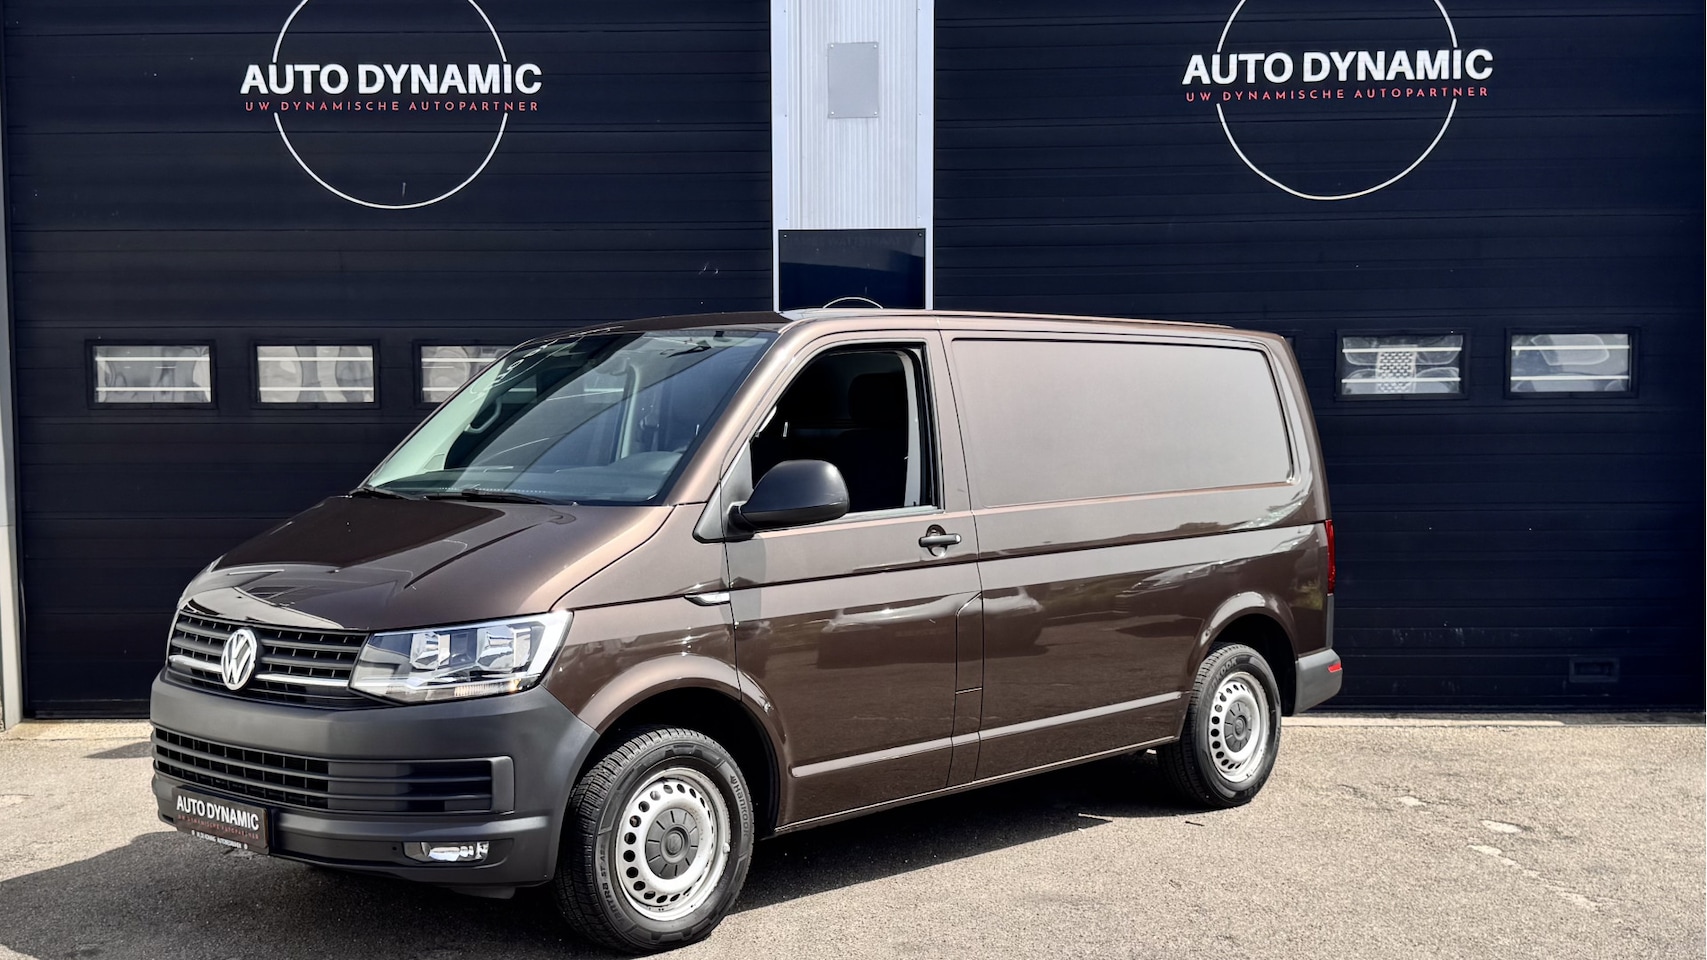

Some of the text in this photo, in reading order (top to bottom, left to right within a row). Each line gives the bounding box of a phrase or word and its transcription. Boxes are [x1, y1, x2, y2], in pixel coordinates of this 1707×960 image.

[240, 63, 543, 95] AUTO DYNAMIC
[1182, 49, 1494, 85] AUTO DYNAMIC
[245, 101, 539, 111] UW DYNAMISCHE AUTOPARTNER
[1185, 86, 1489, 102] UW DYNAMISCHE AUTOPARTNER
[176, 795, 260, 831] AUTO DYNAMIC
